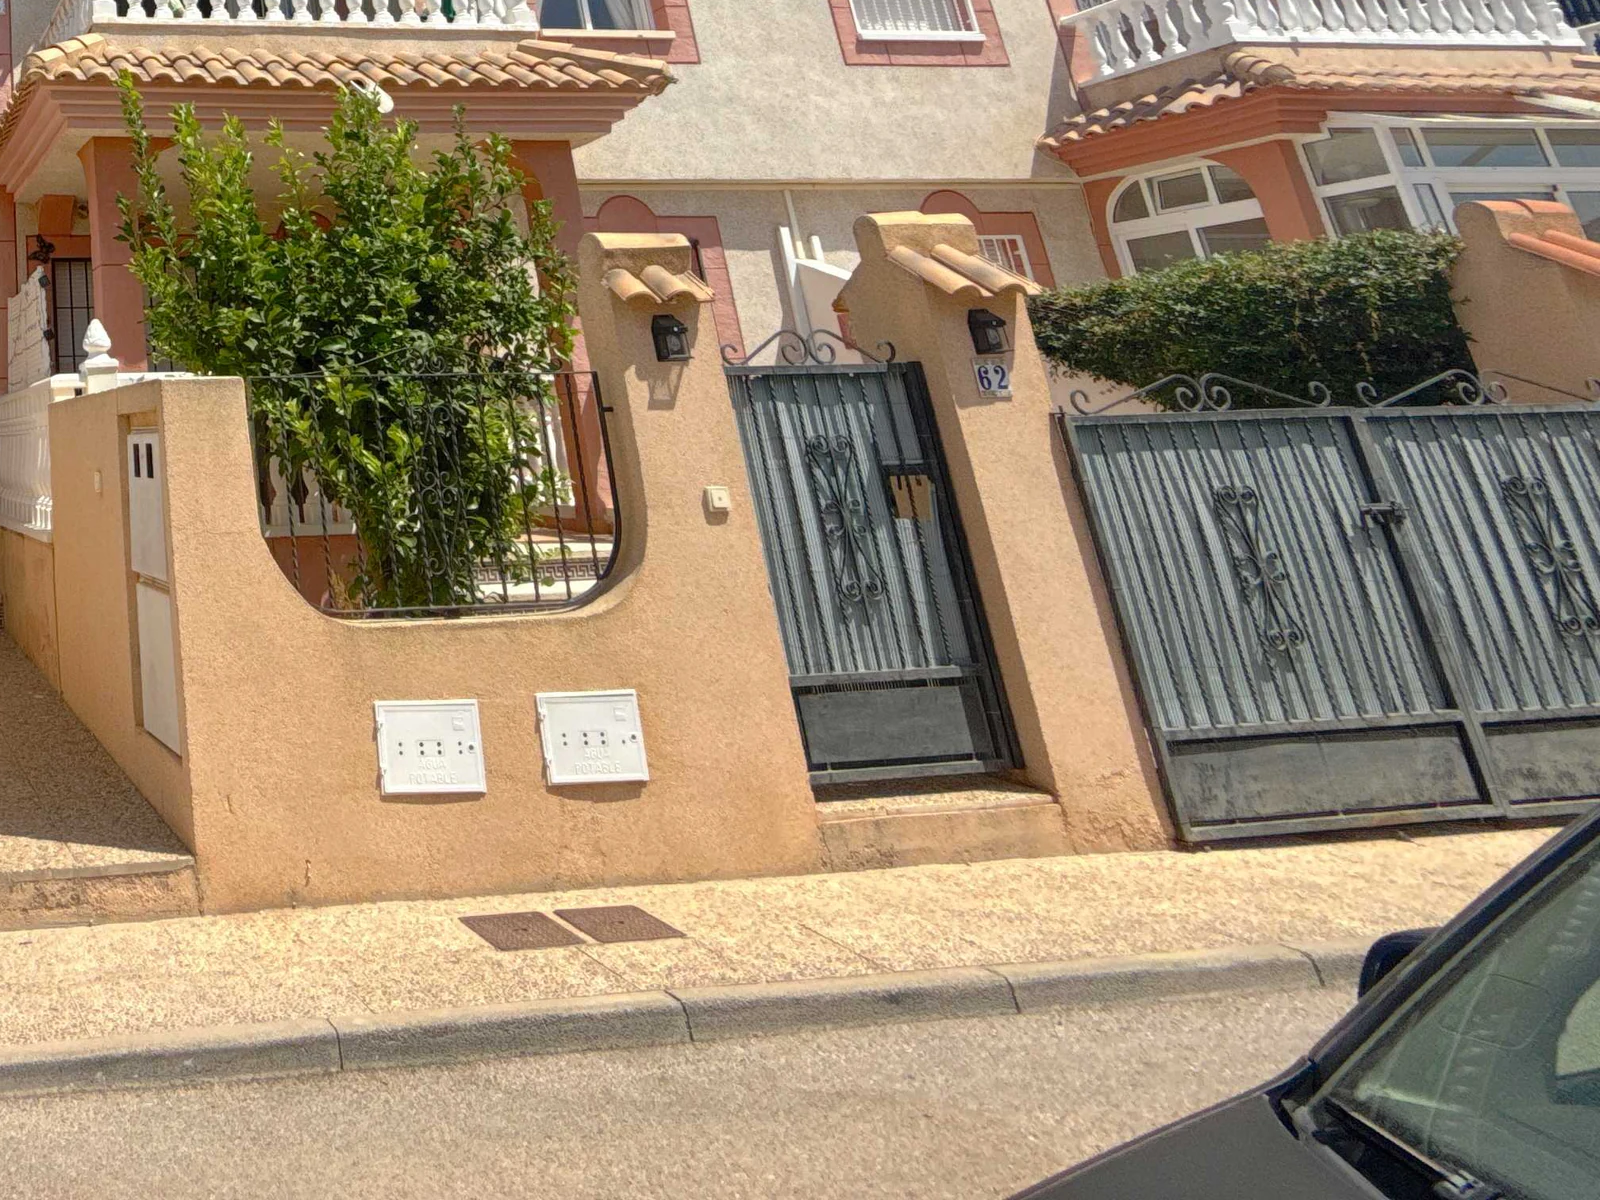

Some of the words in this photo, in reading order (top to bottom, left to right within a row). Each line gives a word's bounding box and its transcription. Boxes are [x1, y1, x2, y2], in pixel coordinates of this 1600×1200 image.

[977, 365, 1009, 390] 62
[418, 756, 447, 770] AGUA
[408, 770, 458, 785] POTABLE
